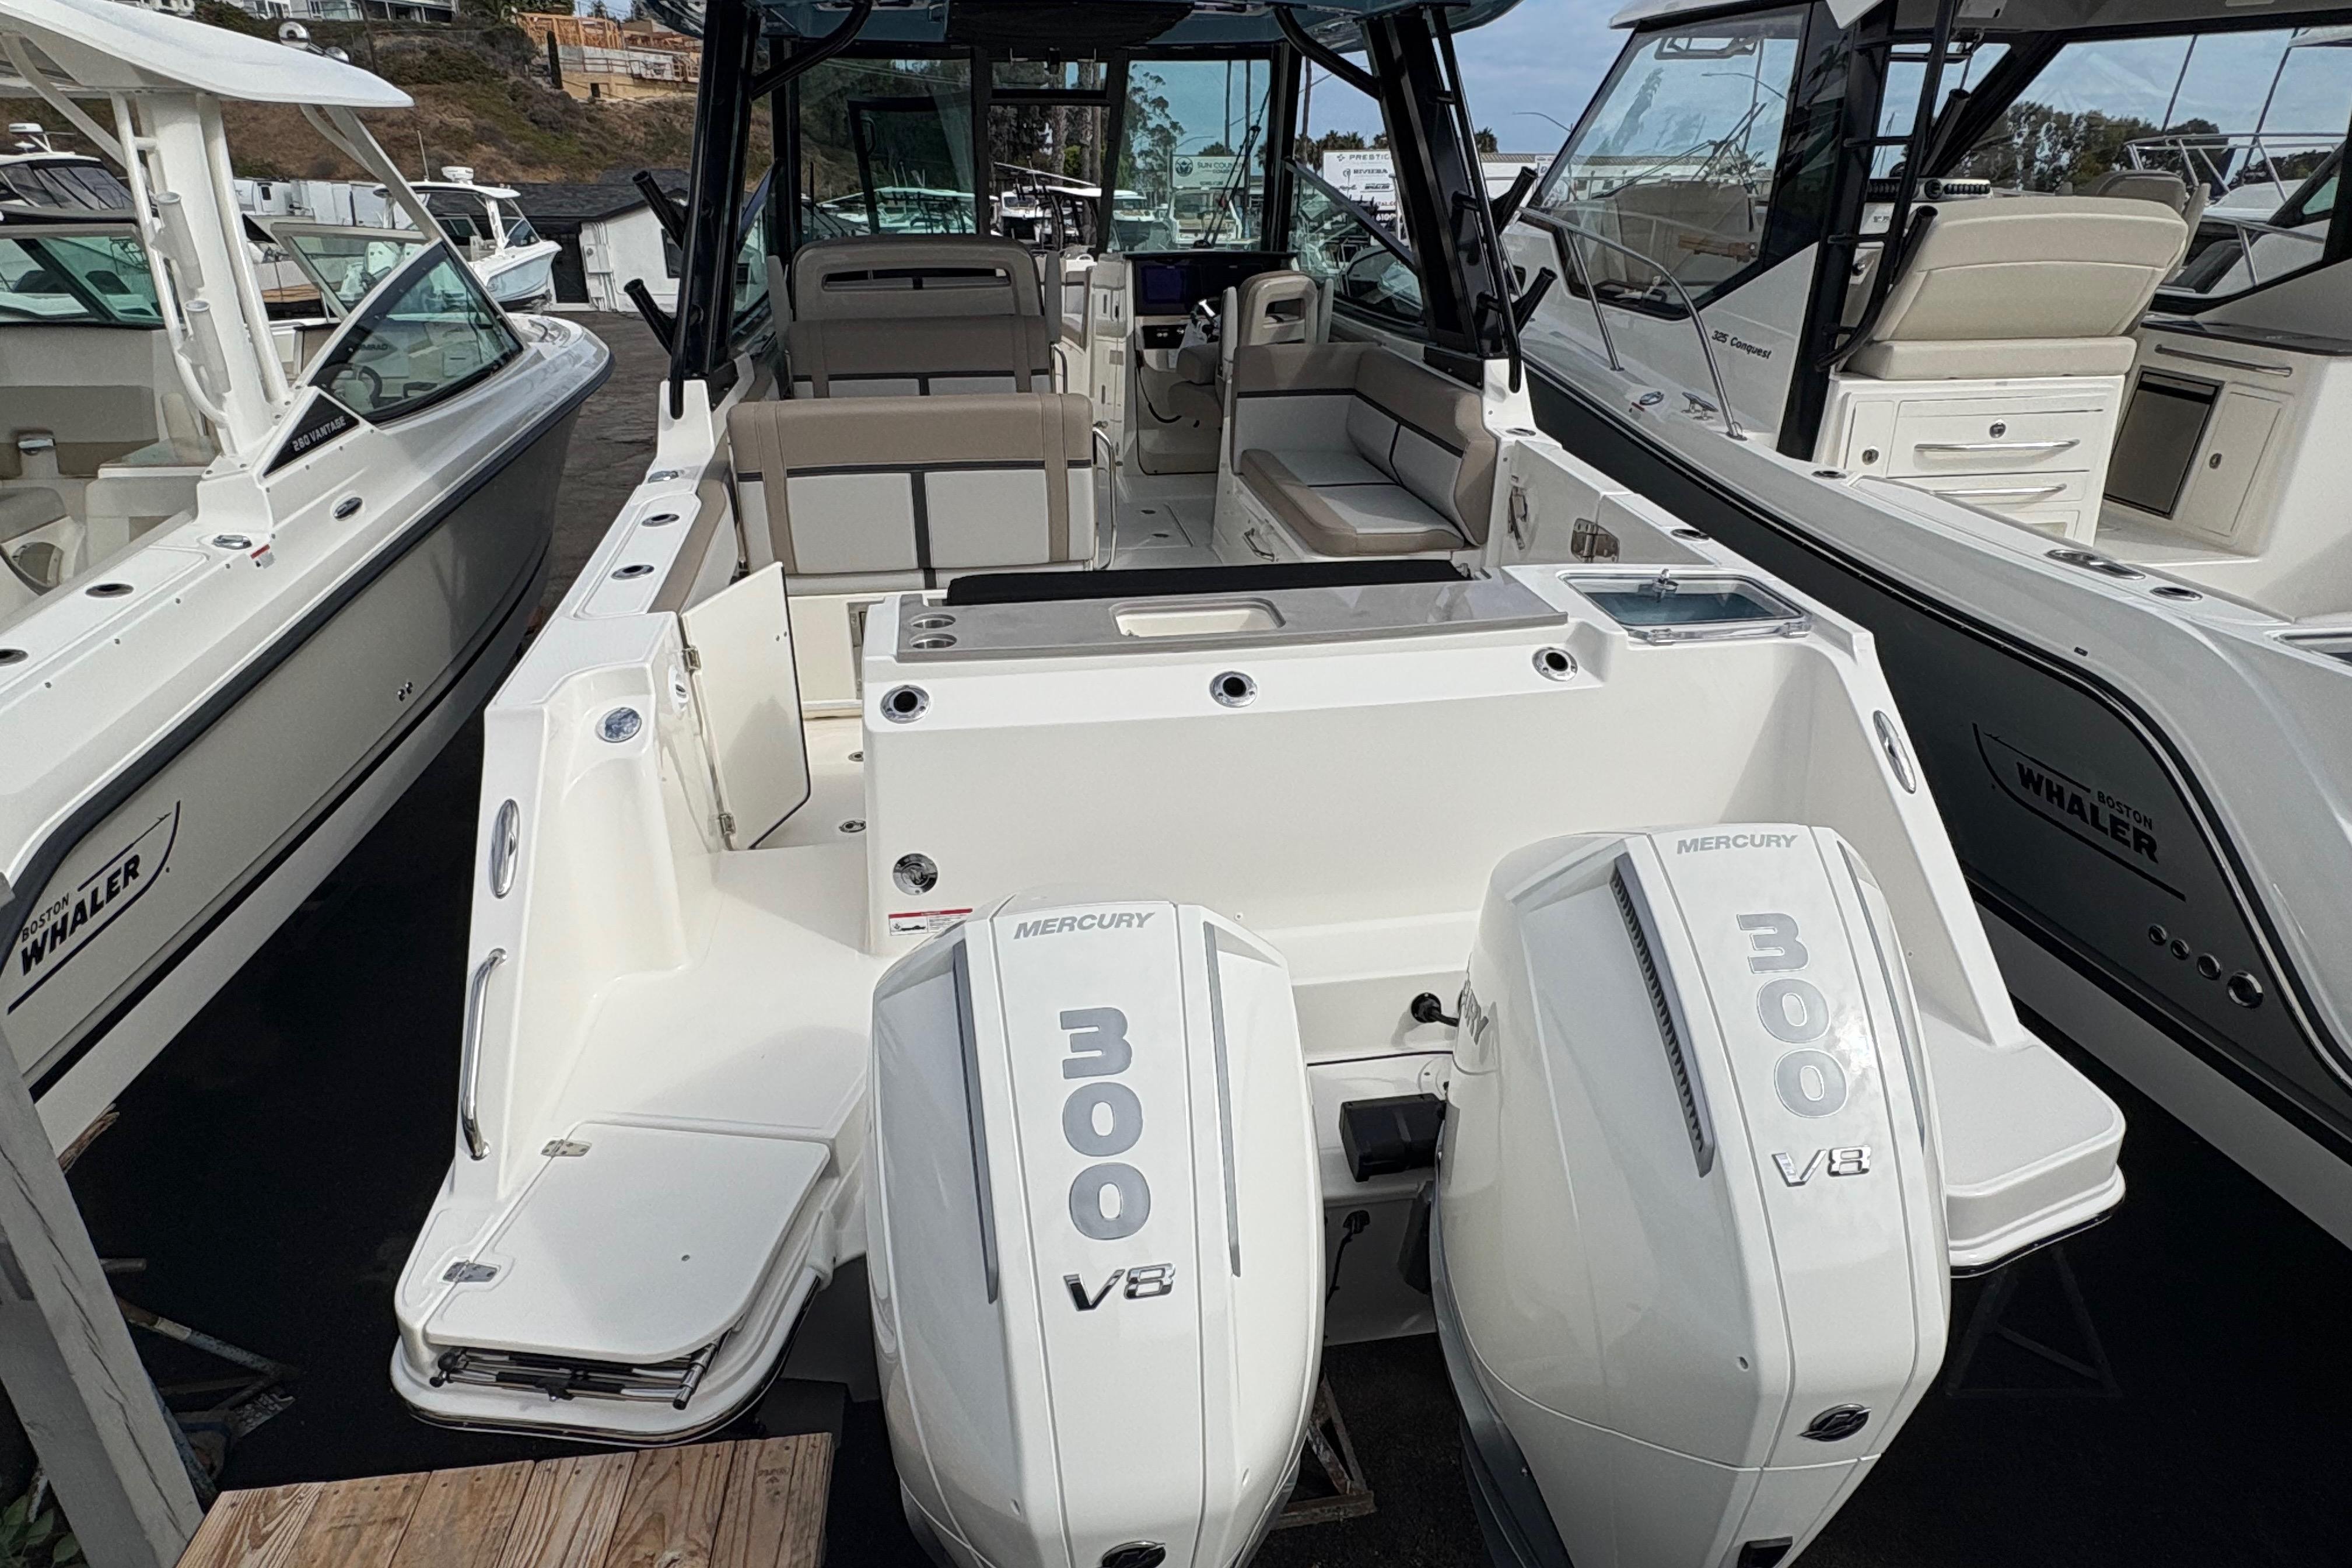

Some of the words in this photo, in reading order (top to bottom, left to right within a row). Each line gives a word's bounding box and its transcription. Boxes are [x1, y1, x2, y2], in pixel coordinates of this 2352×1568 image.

[1712, 330, 1729, 344] 325
[1730, 337, 1772, 359] Conquest
[308, 415, 347, 443] VANTAGE
[2016, 761, 2159, 864] WHALER
[2097, 790, 2153, 831] BOSTON
[1676, 834, 1798, 855] MERCURY
[20, 854, 141, 976] WHALER
[21, 892, 70, 943] BOSTON
[1013, 911, 1156, 940] MERCURY
[1736, 912, 1849, 1119] 300
[1059, 1007, 1152, 1240] 300
[1771, 1145, 1872, 1188] V8
[1063, 1262, 1177, 1312] V8
